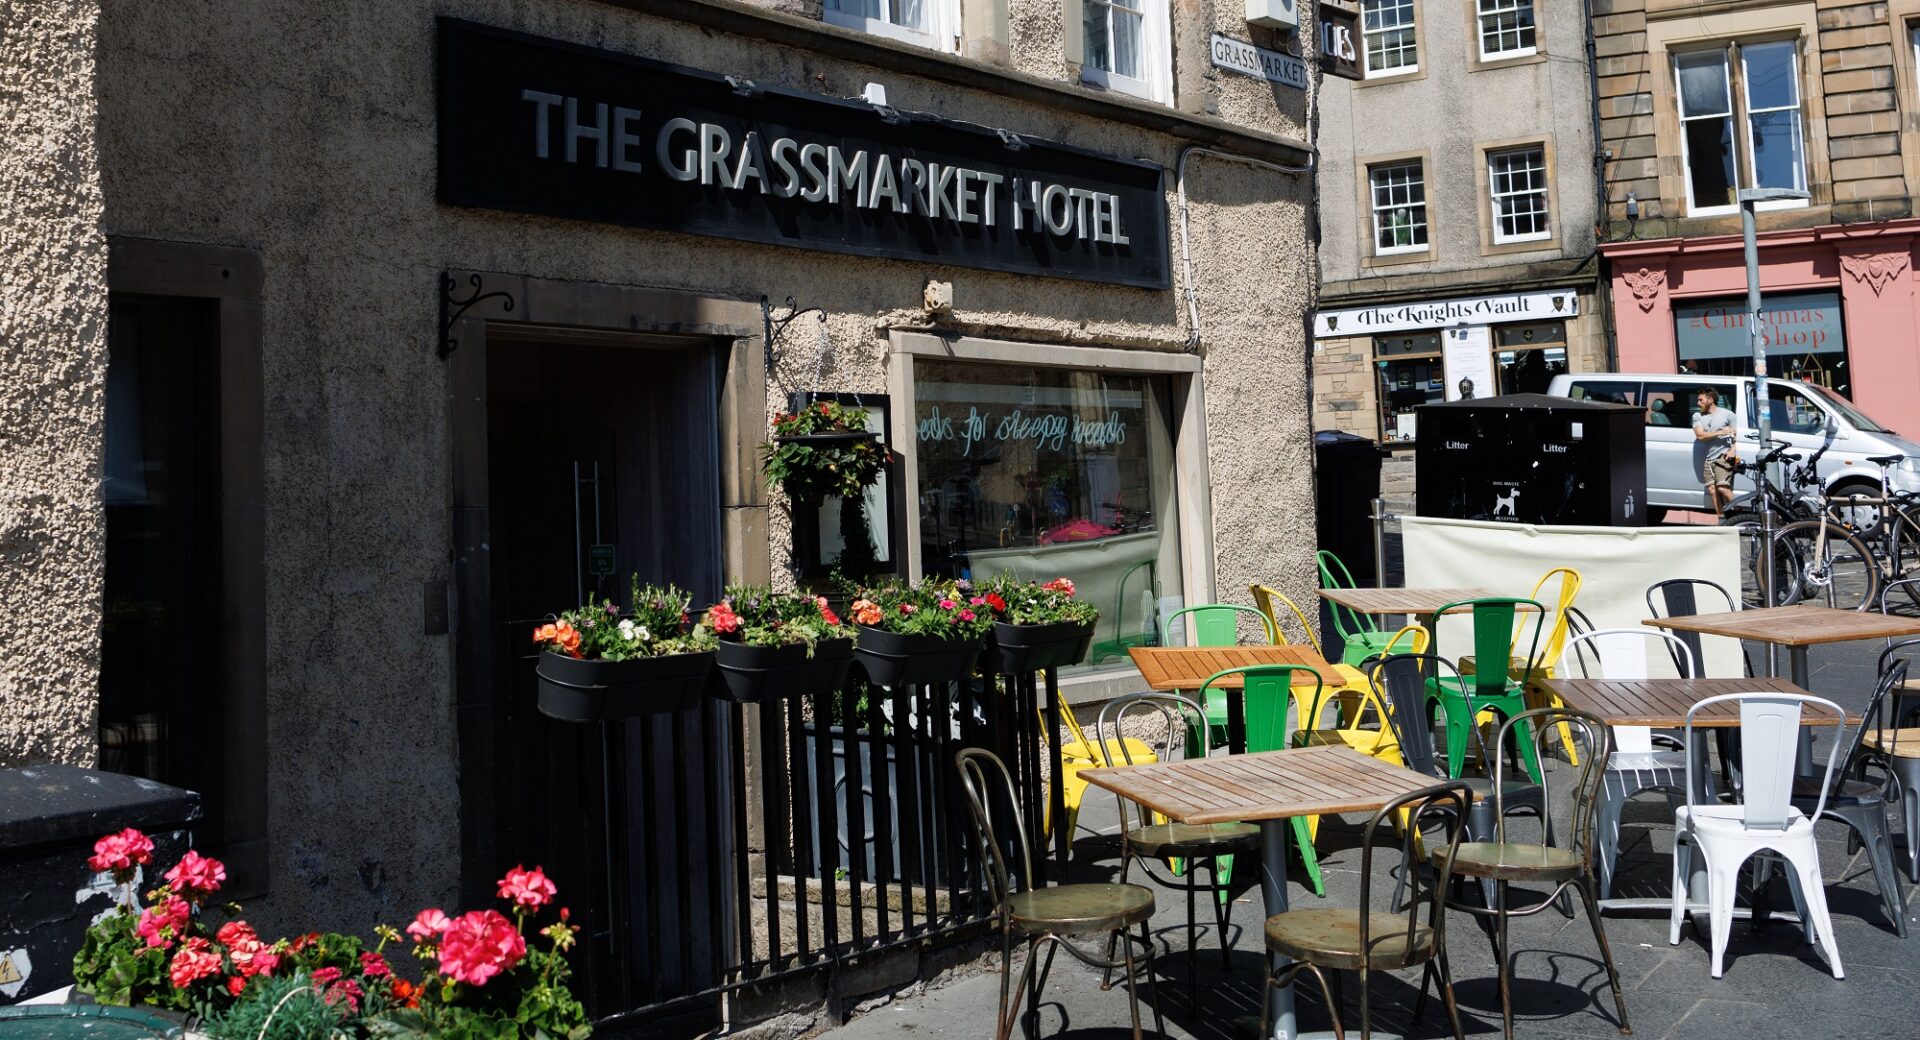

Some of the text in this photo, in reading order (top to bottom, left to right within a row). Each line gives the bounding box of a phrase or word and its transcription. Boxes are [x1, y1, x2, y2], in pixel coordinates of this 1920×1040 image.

[1214, 41, 1305, 84] GRASSMARKET
[521, 89, 1130, 245] THE GRASSMARKET HOTEL
[1357, 295, 1530, 325] The Knights Vault
[1703, 307, 1824, 330] Chrstmas
[915, 406, 953, 442] eds
[961, 406, 989, 457] for
[995, 410, 1068, 451] sleepy
[1446, 441, 1470, 450] Litter
[1543, 444, 1568, 453] Litter
